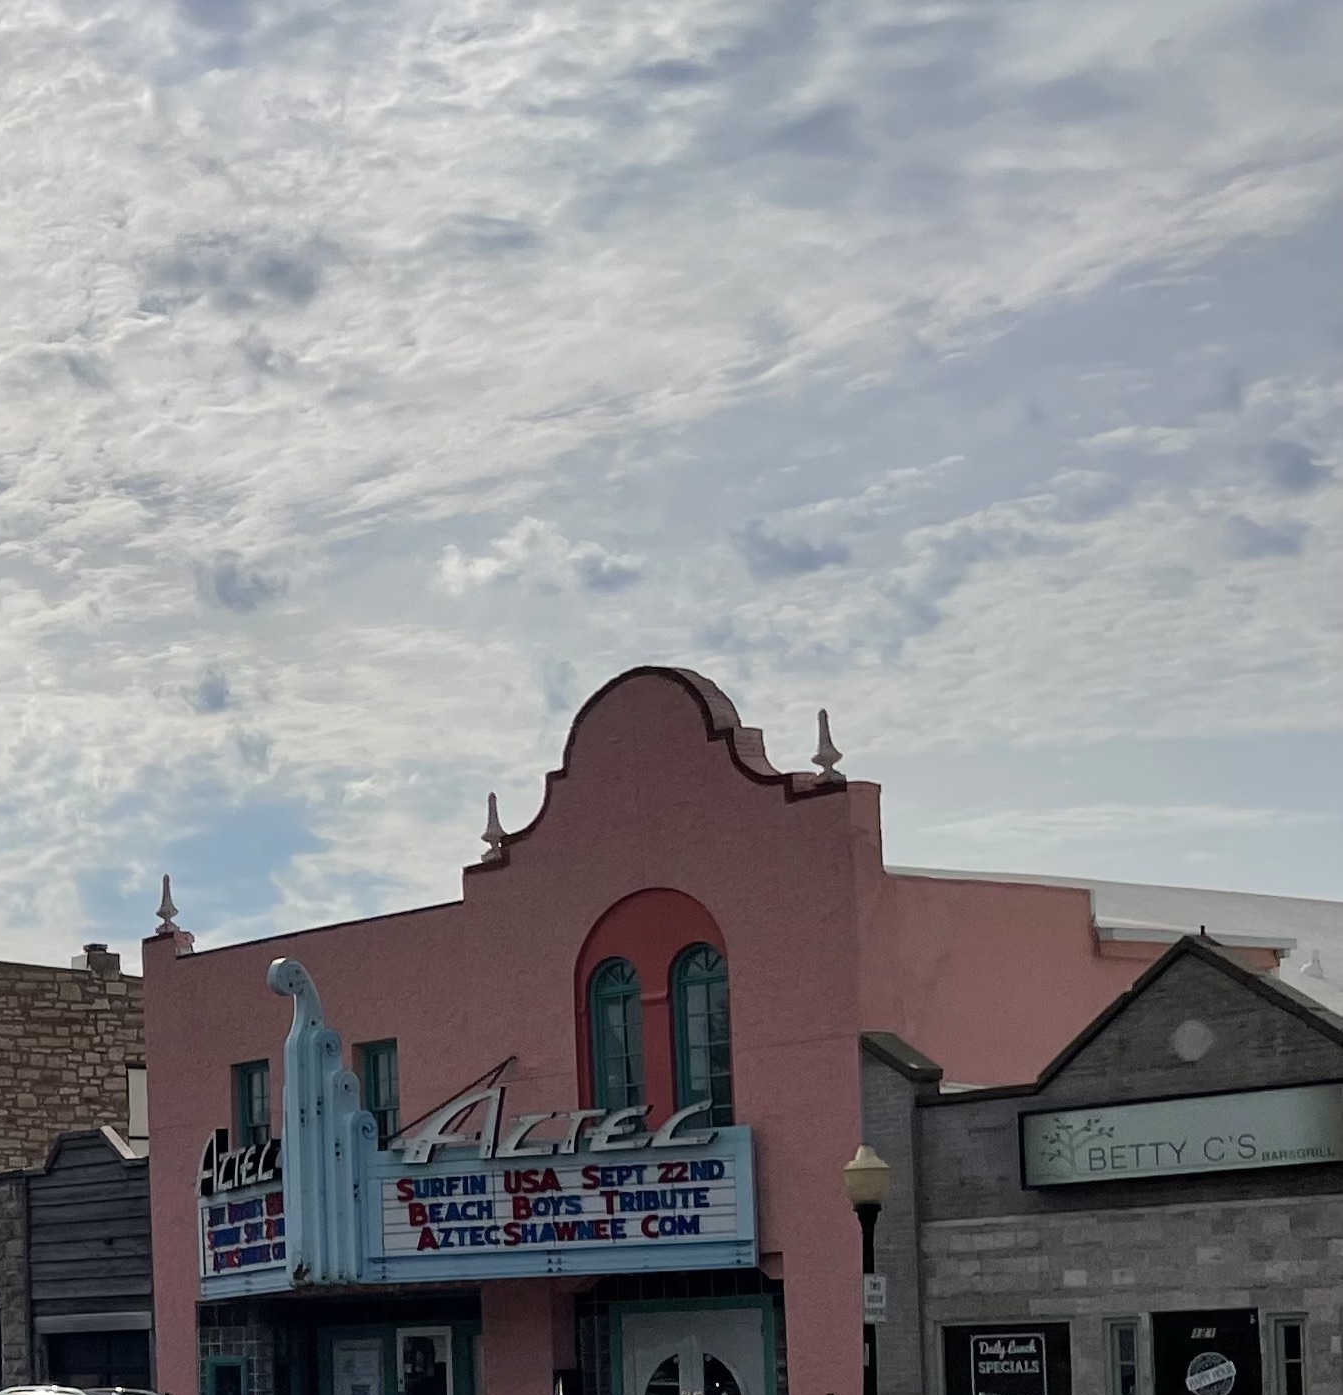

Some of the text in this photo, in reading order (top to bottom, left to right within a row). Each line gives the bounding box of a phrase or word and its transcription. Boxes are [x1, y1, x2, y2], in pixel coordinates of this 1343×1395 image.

[391, 1086, 720, 1164] AZTEC
[1087, 1139, 1187, 1172] BETTY
[1203, 1133, 1258, 1163] C'S
[396, 1159, 726, 1203] SURFIN USA SEPT 22ND
[408, 1187, 711, 1227] BEACH BOYS TRIBUTE
[640, 1214, 701, 1239] COM
[978, 1360, 1040, 1374] SPECIALS
